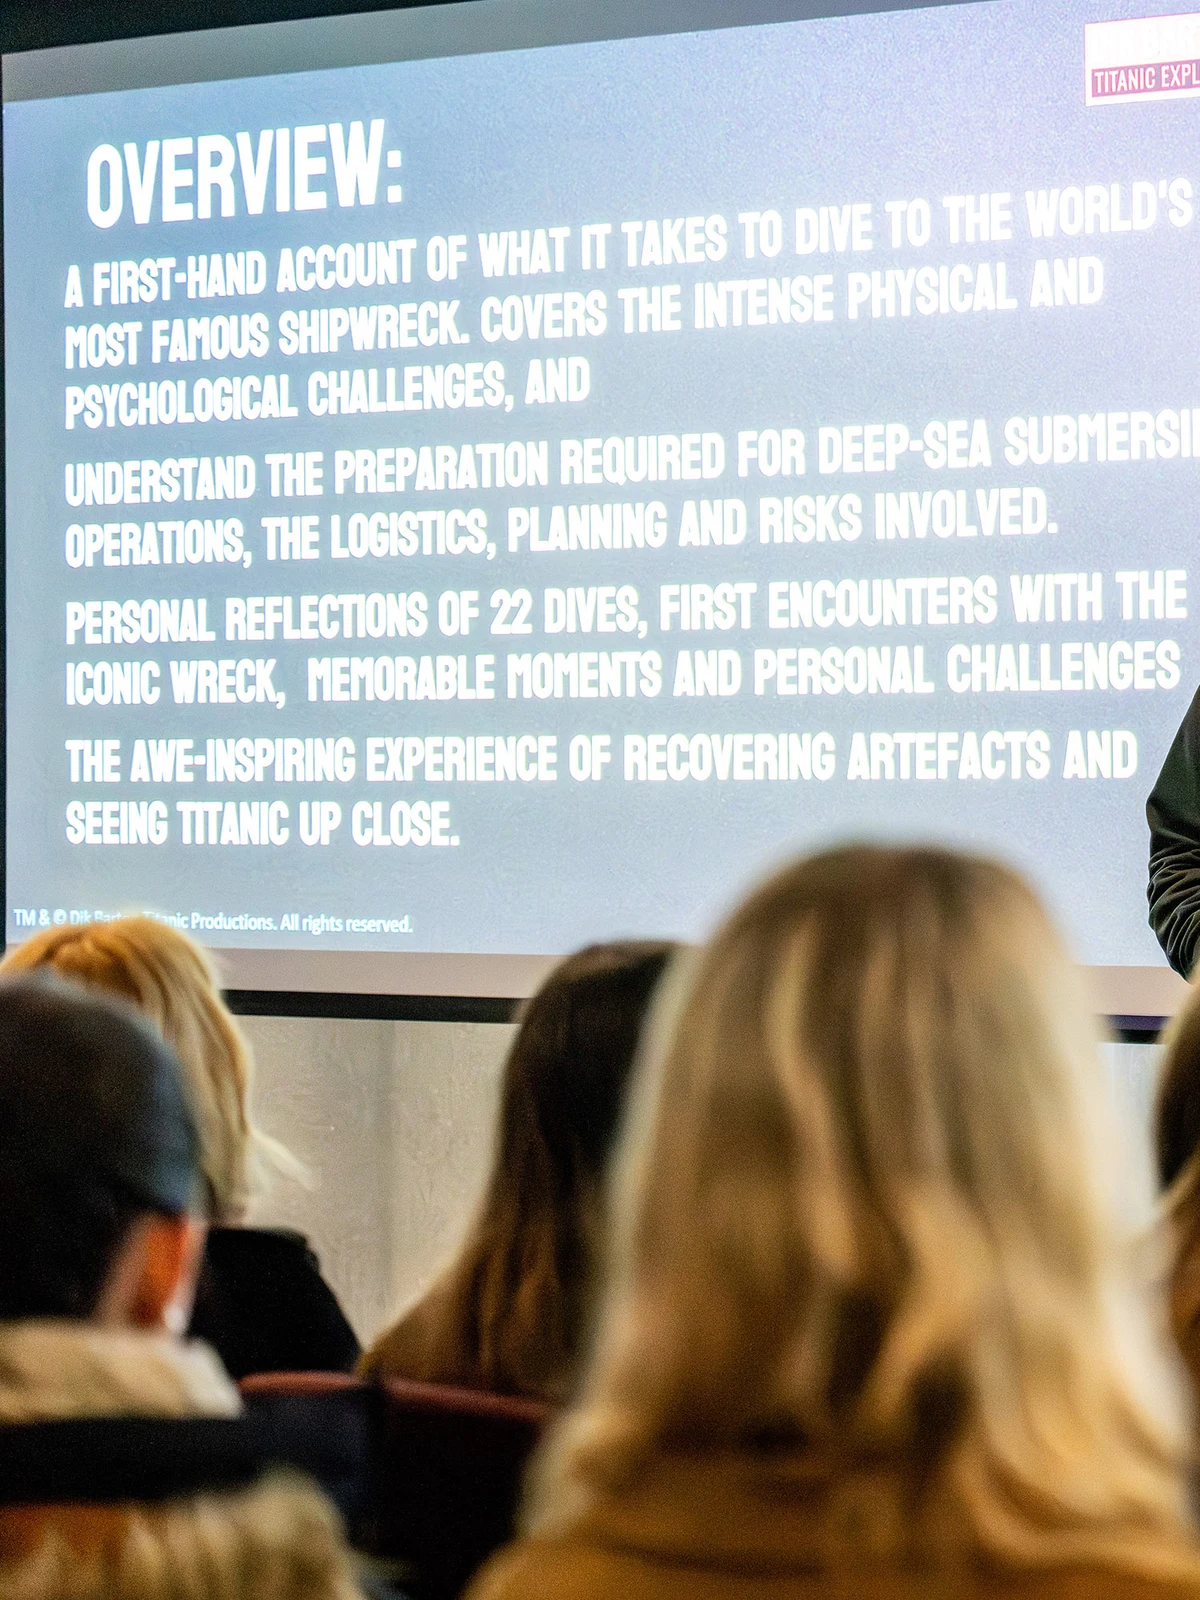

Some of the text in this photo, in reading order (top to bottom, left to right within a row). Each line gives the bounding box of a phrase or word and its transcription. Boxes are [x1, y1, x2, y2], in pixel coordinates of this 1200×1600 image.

[1094, 67, 1156, 94] TITANIC
[87, 119, 402, 228] OVERVIEW:
[65, 178, 1193, 307] A FIRST-HAND ACCOUNT OF WHAT IT TAKES TO DIVE TO THE WORLD'S
[66, 257, 1102, 369] MOST FAMOUS SHIPWRECK. COVERS THE INTENSE PHYSICAL AND
[66, 357, 589, 429] PSYCHOLOGICAL CHALLENGES, AND
[66, 456, 255, 506] UNDERSTAND
[266, 453, 323, 496] THE
[335, 441, 547, 493] PREPARATION
[562, 432, 725, 485] REQUIRED
[738, 429, 806, 477] FOR
[819, 420, 991, 473] DEEP-SEA
[66, 487, 1057, 568] OPERATIONS, THE LOGISTICS, PLANNING AND RISKS INVOLVED.
[66, 570, 1187, 644] PERSONAL REFLECTIONS OF 22 DIVES, FIRST ENCOUNTERS WITH THE
[66, 640, 1181, 708] ICONIC WRECK, MEMORABLE MOMENTS AND PERSONAL CHALLENGES
[66, 730, 1138, 782] THE AWE-INSPIRING EXPERIENCE OF RECOVERING ARTEFACTS AND
[66, 800, 459, 846] SEEING TITANIC UP CLOSE.
[13, 908, 37, 927] TM
[38, 908, 51, 926] &
[190, 911, 278, 931] Productions.
[280, 913, 300, 931] All
[302, 915, 343, 935] rights
[345, 915, 413, 934] reserved.
